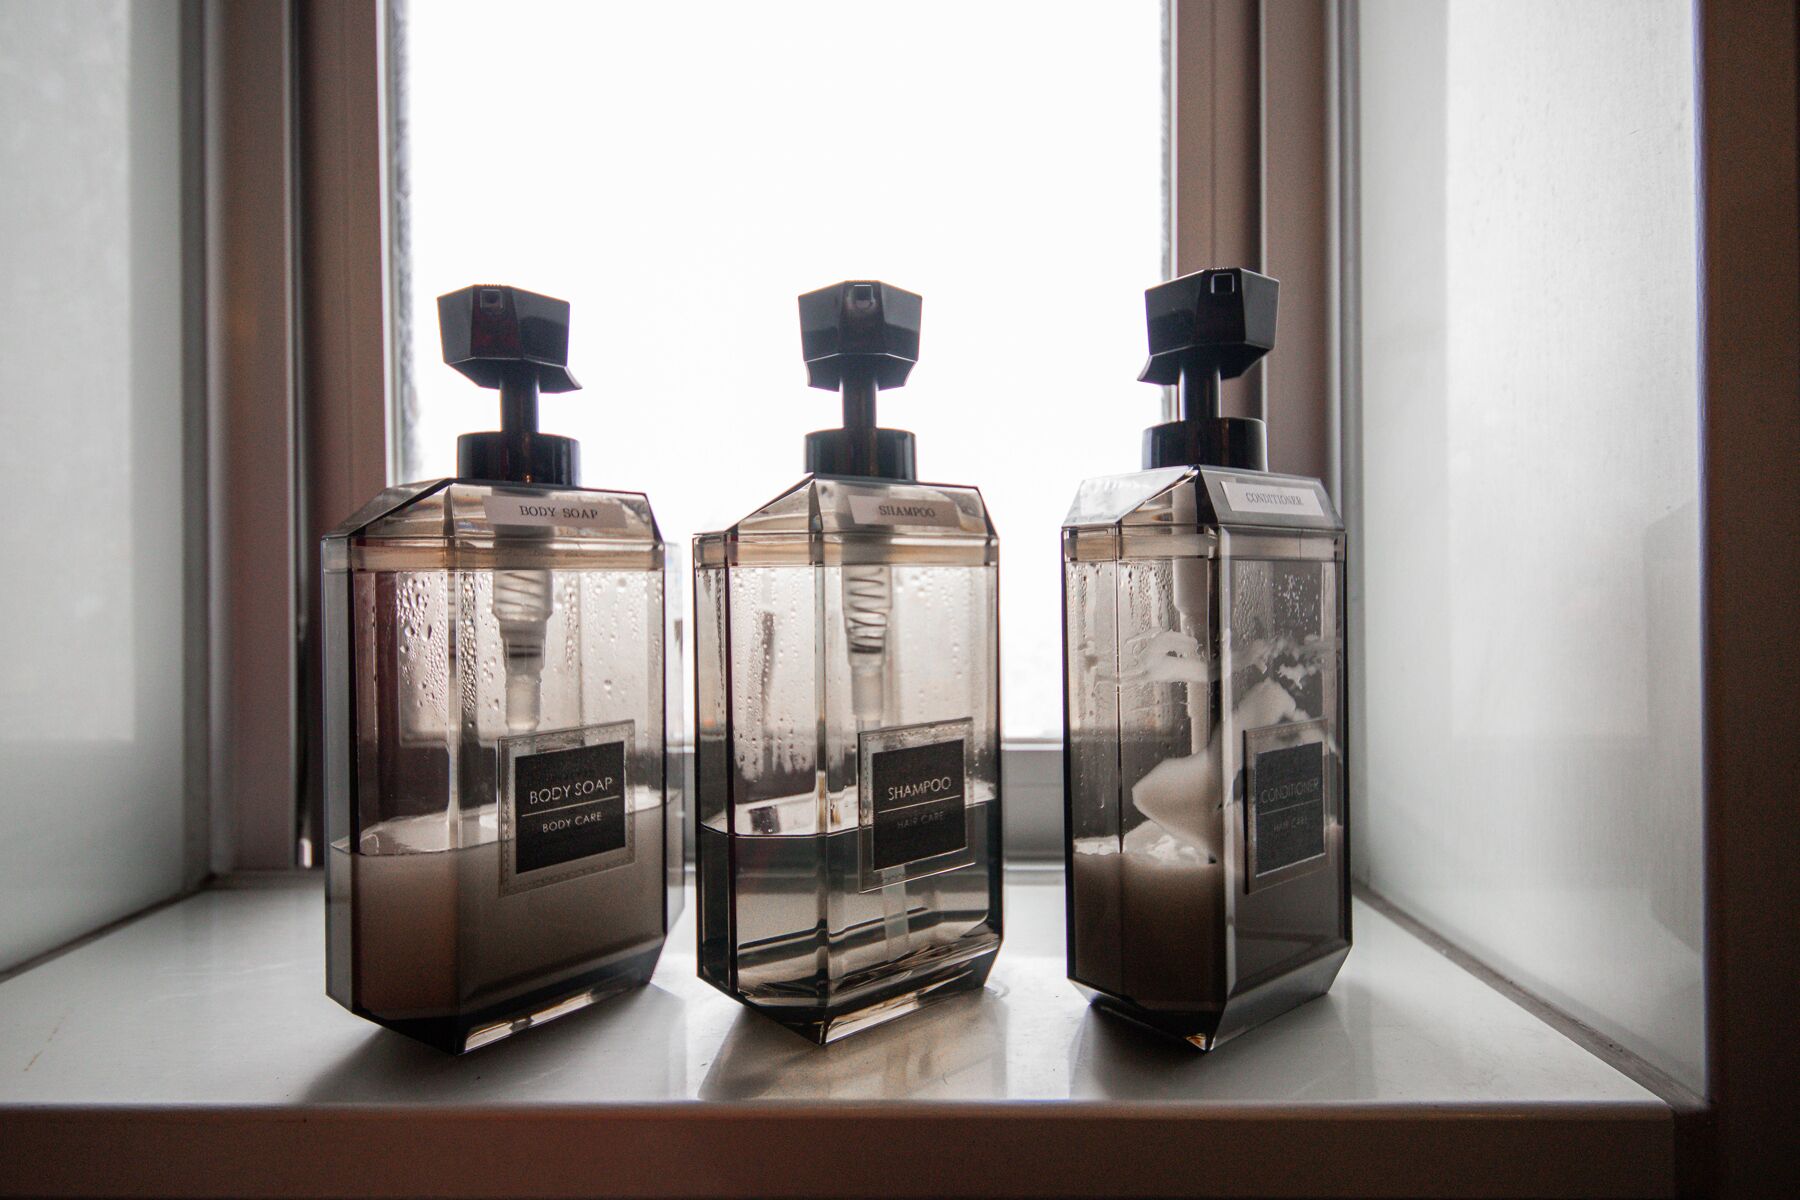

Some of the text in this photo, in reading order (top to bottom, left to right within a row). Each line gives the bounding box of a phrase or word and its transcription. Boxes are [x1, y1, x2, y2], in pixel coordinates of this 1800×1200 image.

[1246, 492, 1304, 506] CONDITIONER
[520, 506, 598, 519] BODY SOAP
[879, 505, 936, 518] SHAMPOO
[529, 777, 613, 805] BODY SOAP
[888, 776, 952, 801] SHAMPOO
[1261, 778, 1319, 803] CONDITIONER
[542, 811, 602, 833] BODY CARE
